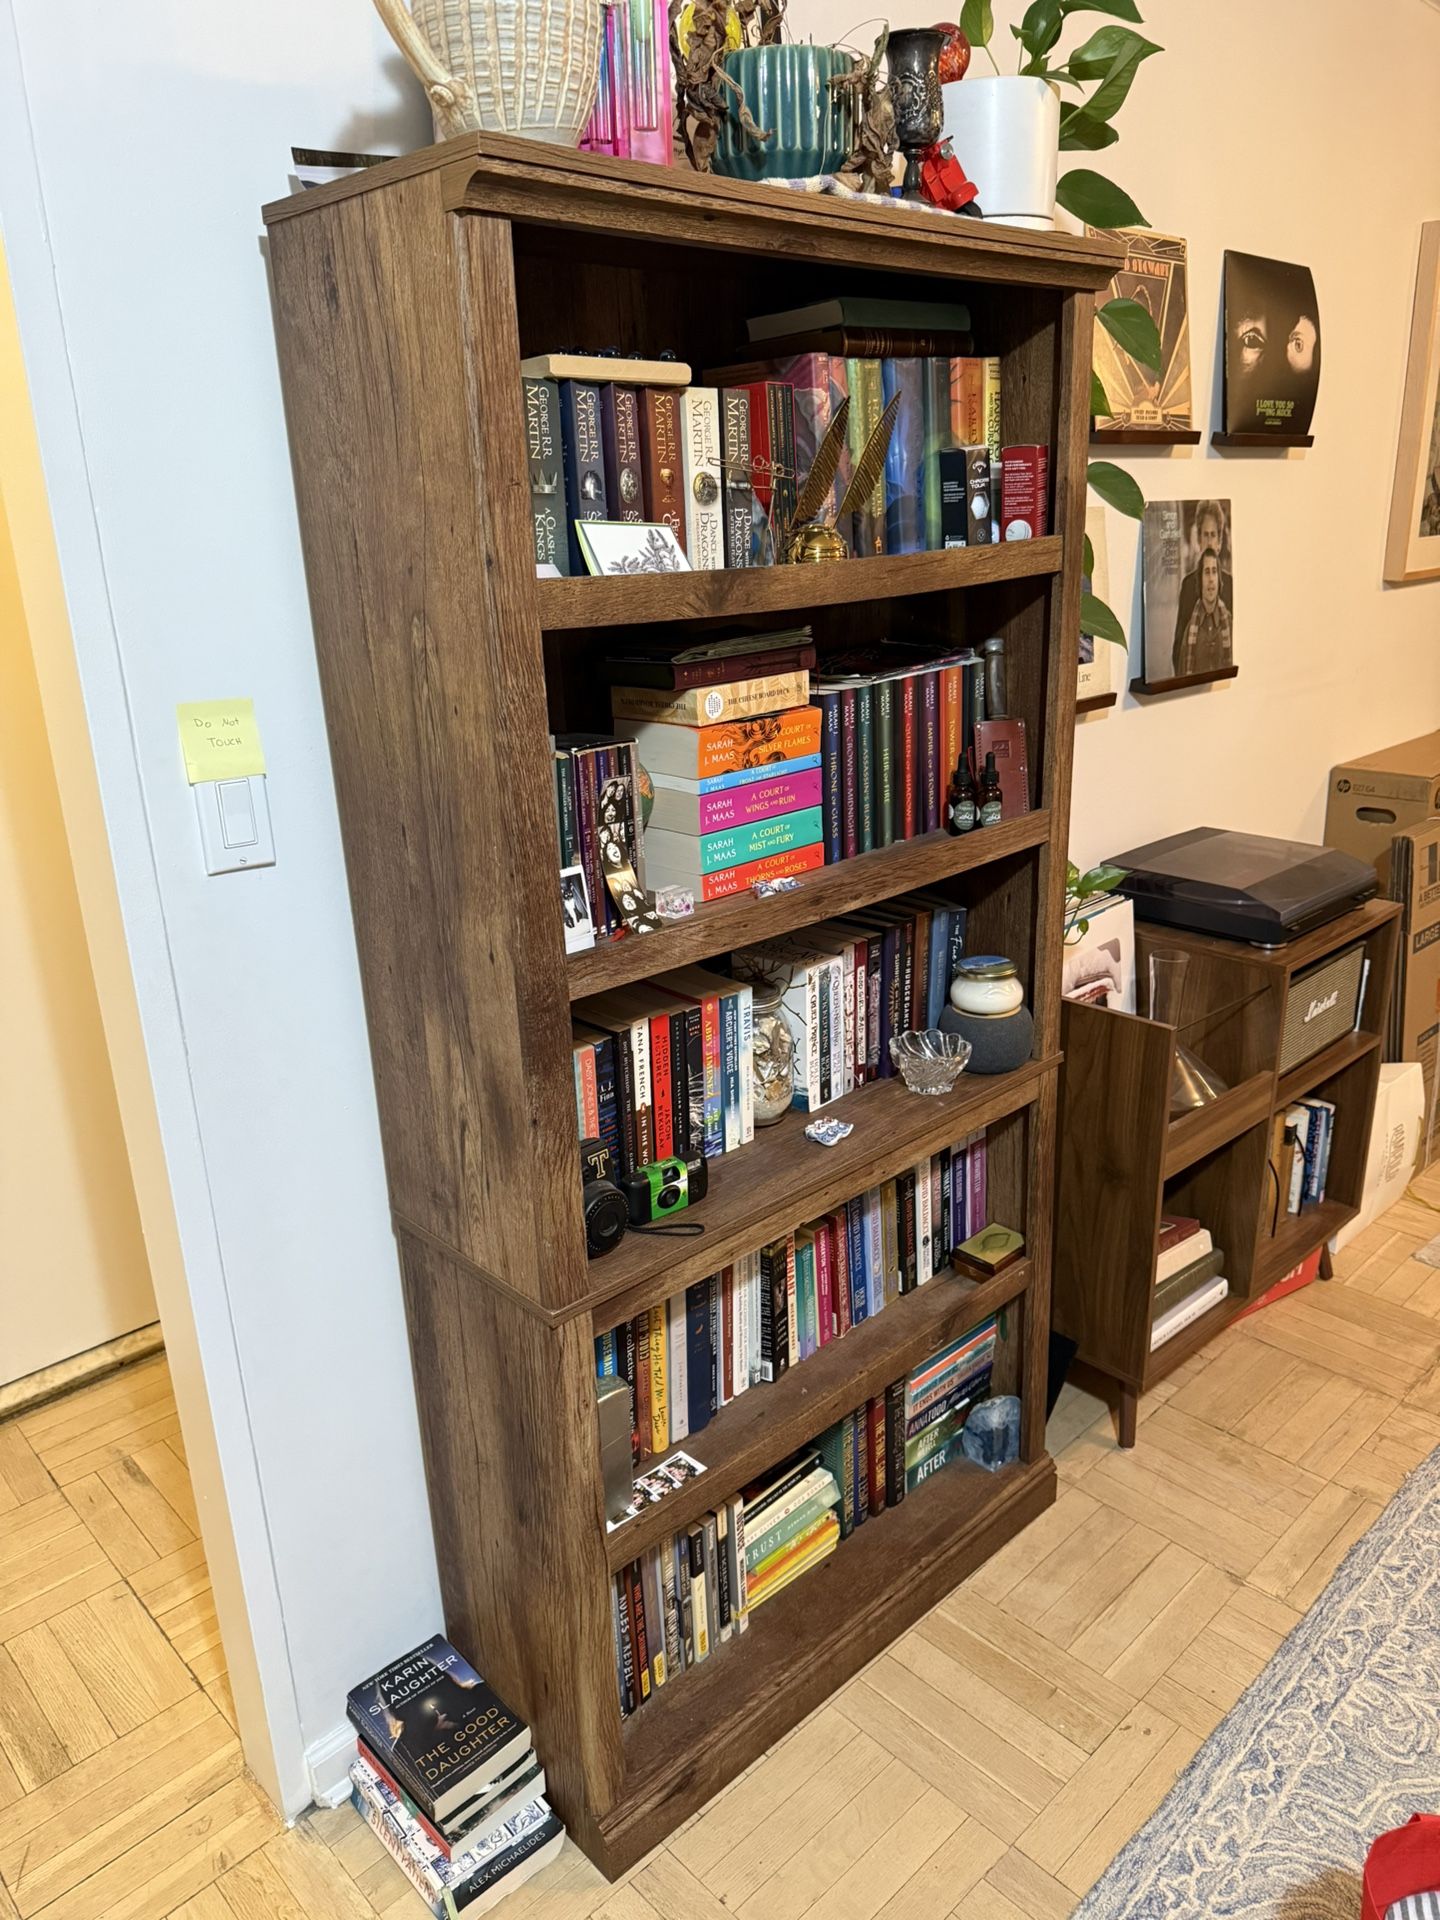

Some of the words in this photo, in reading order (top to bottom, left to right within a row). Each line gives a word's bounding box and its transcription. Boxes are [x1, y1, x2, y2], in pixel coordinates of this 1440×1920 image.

[526, 385, 540, 459] MARTIN
[539, 387, 549, 434] GEORGE
[586, 391, 596, 437] GEORGE
[624, 393, 634, 439] GEORGE
[665, 395, 673, 437] GEORGE
[703, 400, 712, 443] GEORGE
[739, 399, 748, 444] GEORGE
[576, 390, 589, 462] MARTIN
[616, 392, 628, 463] MARTIN
[654, 394, 667, 463] MARTIN
[692, 400, 703, 467] MARTIN
[727, 397, 740, 462] MARTIN
[535, 514, 546, 560] KINGS
[709, 519, 717, 554] DANCE
[738, 694, 758, 704] CHEESE
[758, 690, 776, 699] BOARD
[777, 687, 790, 696] DECK
[193, 718, 212, 729] Do
[222, 717, 239, 728] Not
[781, 724, 804, 736] COURT
[207, 737, 242, 749] TOUCH
[707, 738, 734, 752] SARAH
[712, 751, 735, 763] MAAS
[758, 741, 782, 754] SILVER
[784, 735, 812, 748] FLAMES
[846, 736, 854, 775] CROWN
[830, 751, 838, 794] THRONE
[863, 748, 871, 801] ASSASSIN'S
[882, 748, 890, 771] HEIR
[707, 798, 734, 812] SARAH
[745, 801, 769, 814] WINGS
[779, 793, 796, 806] RUIN
[751, 792, 757, 801] A
[759, 786, 785, 799] COURT
[713, 809, 735, 822] MAAS
[831, 808, 839, 838] GLASS
[847, 788, 855, 838] MIDNIGHT
[708, 837, 734, 852] SARAH
[748, 839, 768, 852] MIST
[776, 833, 795, 845] FURY
[751, 831, 758, 839] A
[759, 825, 785, 838] COURT
[714, 848, 737, 861] MAAS
[757, 862, 763, 870] A
[764, 856, 790, 869] COURT
[708, 869, 736, 884] SARAH
[715, 881, 738, 894] MAAS
[745, 872, 775, 885] THORNS
[783, 861, 807, 875] ROSES
[951, 936, 963, 961] Fine
[705, 1020, 713, 1048] ABBY
[725, 1011, 733, 1050] ARCHER'S
[743, 1005, 751, 1042] TRAVIS
[586, 1058, 594, 1081] DAISY
[638, 1059, 646, 1099] FRENCH
[706, 1051, 714, 1098] JIMENEZ
[726, 1052, 734, 1076] VOICE
[586, 1083, 594, 1109] JONES
[641, 1116, 648, 1127] IN
[588, 1149, 609, 1178] T
[851, 1209, 860, 1234] DAVID
[787, 1236, 795, 1296] REVENANT
[854, 1235, 862, 1272] BALDACCI
[603, 1333, 613, 1375] OUSEMAID
[651, 1327, 663, 1352] Thing
[626, 1333, 634, 1382] collective
[654, 1354, 662, 1366] He
[653, 1367, 661, 1385] Told
[919, 1394, 934, 1408] ENDS
[918, 1427, 940, 1449] AFTER
[917, 1449, 946, 1482] AFTER
[745, 1530, 782, 1565] TRUST
[633, 1584, 642, 1602] WHO
[618, 1594, 630, 1634] RULES
[635, 1604, 643, 1617] ARE
[636, 1618, 645, 1632] THE
[623, 1644, 634, 1687] REBELS
[638, 1634, 648, 1671] CRIMINALS
[369, 1653, 458, 1717] SLAUGHTER
[381, 1656, 430, 1692] KARIN
[415, 1742, 451, 1768] THE
[454, 1707, 499, 1743] GOOD
[425, 1715, 511, 1782] DAUGHTER
[469, 1874, 492, 1894] ALEX
[492, 1830, 547, 1874] MICHAELIDES
